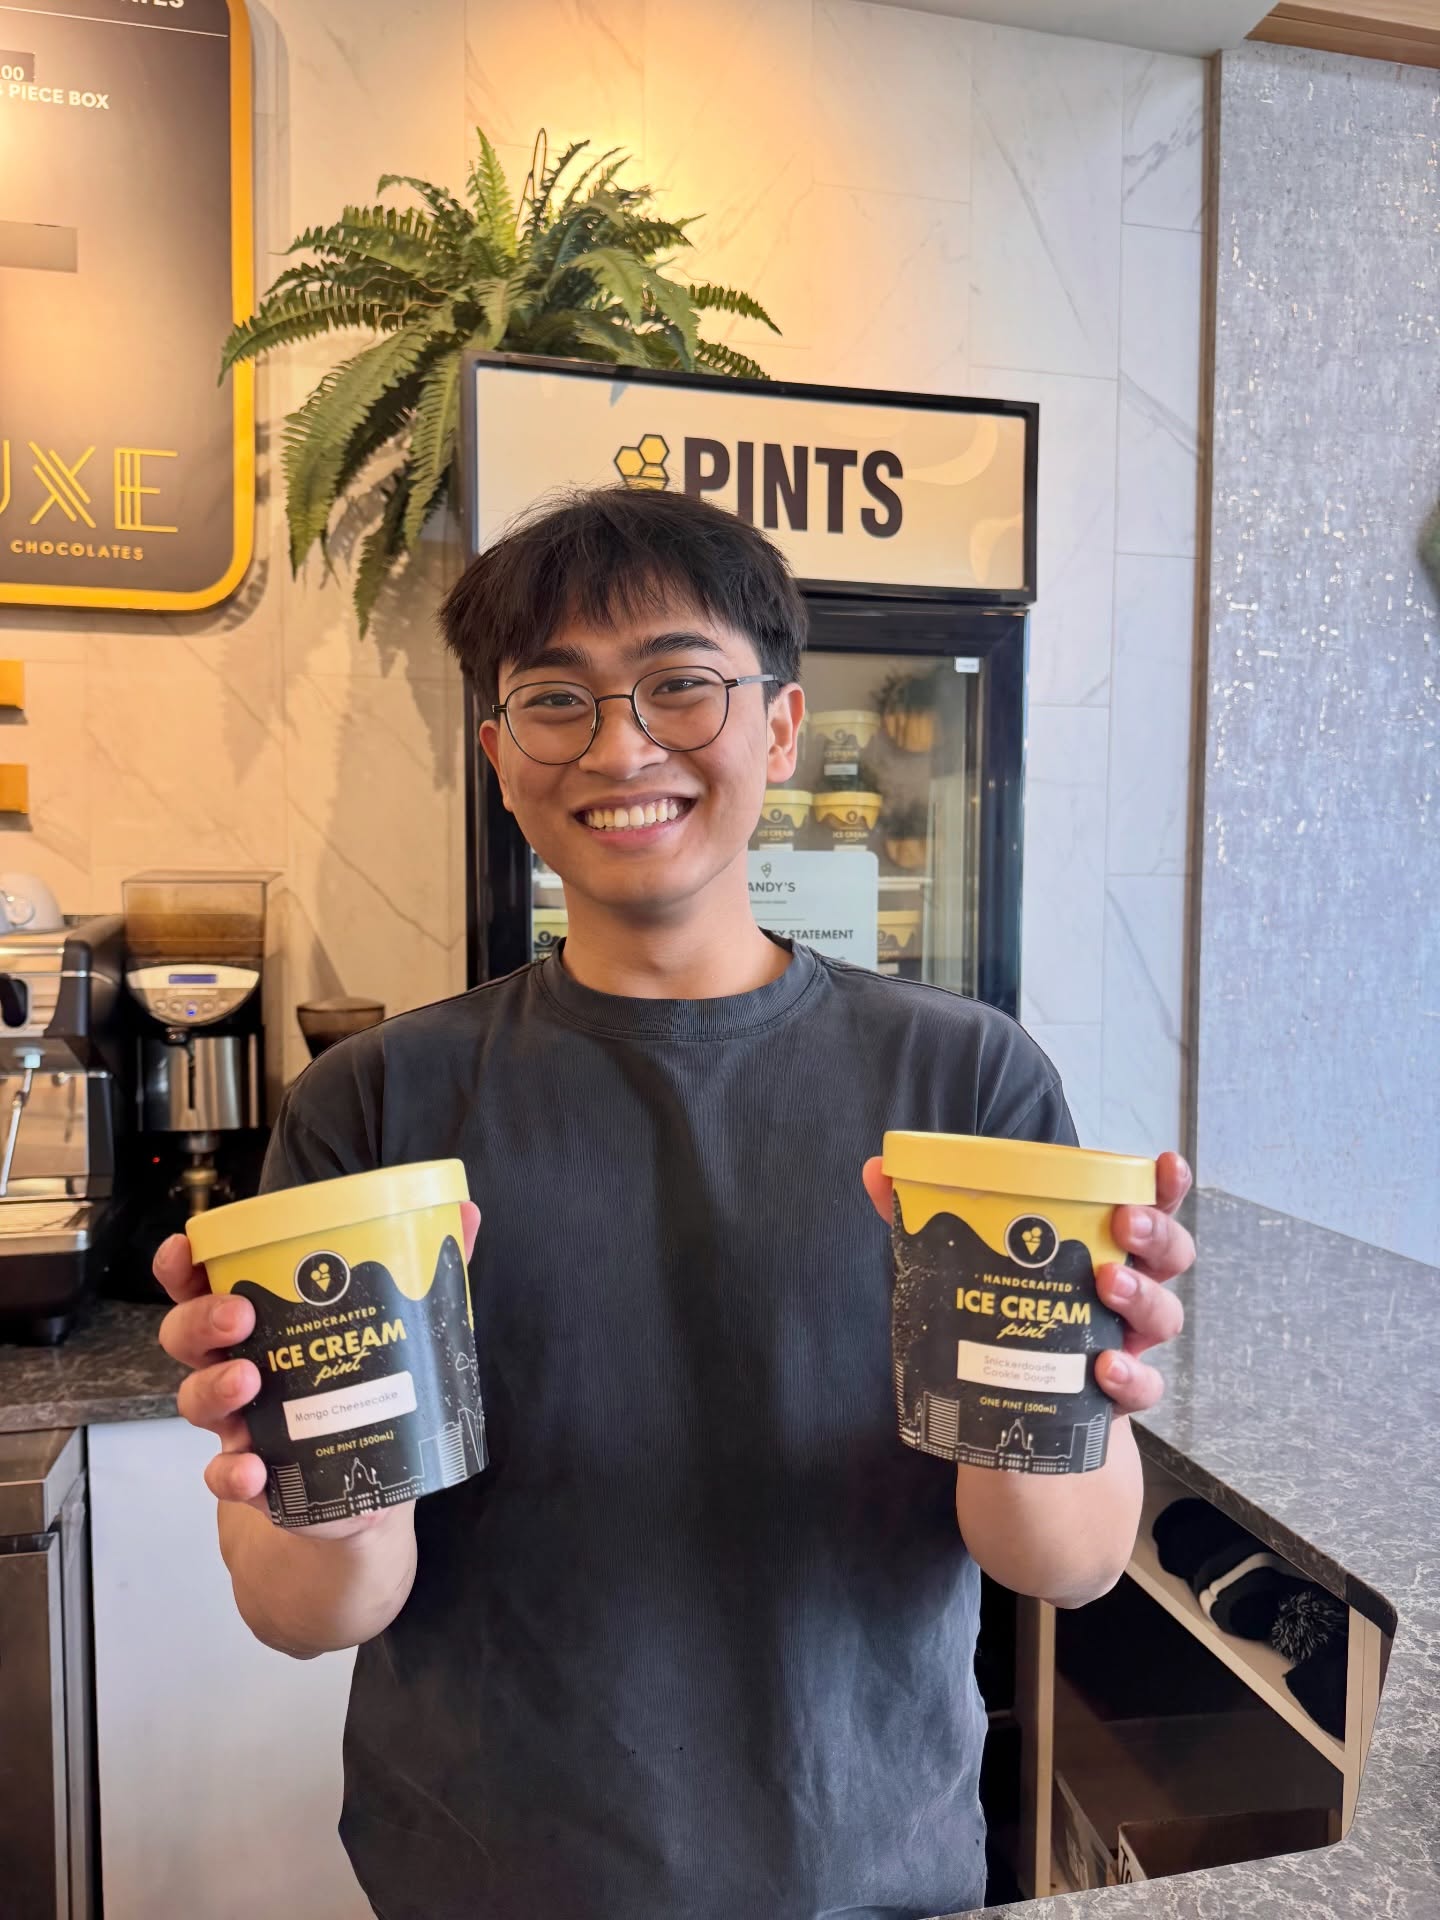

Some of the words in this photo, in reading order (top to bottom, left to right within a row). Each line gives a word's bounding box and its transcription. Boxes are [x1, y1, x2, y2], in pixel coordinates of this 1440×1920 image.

[9, 84, 64, 104] PIECE
[69, 90, 109, 109] BOX
[684, 437, 904, 539] PINTS
[10, 539, 144, 561] CHOCOLATES
[789, 929, 854, 940] STATEMENT
[983, 1273, 1073, 1293] HANDCRAFTED
[956, 1287, 995, 1315] ICE
[1000, 1295, 1091, 1325] CREAM
[286, 1306, 377, 1336] HANDCRAFTED
[996, 1319, 1058, 1340] pint
[267, 1344, 305, 1373] ICE
[309, 1318, 407, 1362] CREAM
[313, 1347, 371, 1387] pint
[983, 1366, 1020, 1380] Cookie
[1023, 1373, 1057, 1385] Dough
[295, 1408, 329, 1423] Mango
[331, 1390, 399, 1416] Cheesecake
[980, 1396, 1000, 1408] ONE
[1002, 1399, 1022, 1410] PINT
[1024, 1402, 1057, 1414] (500mL)
[315, 1445, 335, 1457] ONE
[336, 1440, 357, 1451] PINT
[359, 1429, 395, 1449] (500mL)
